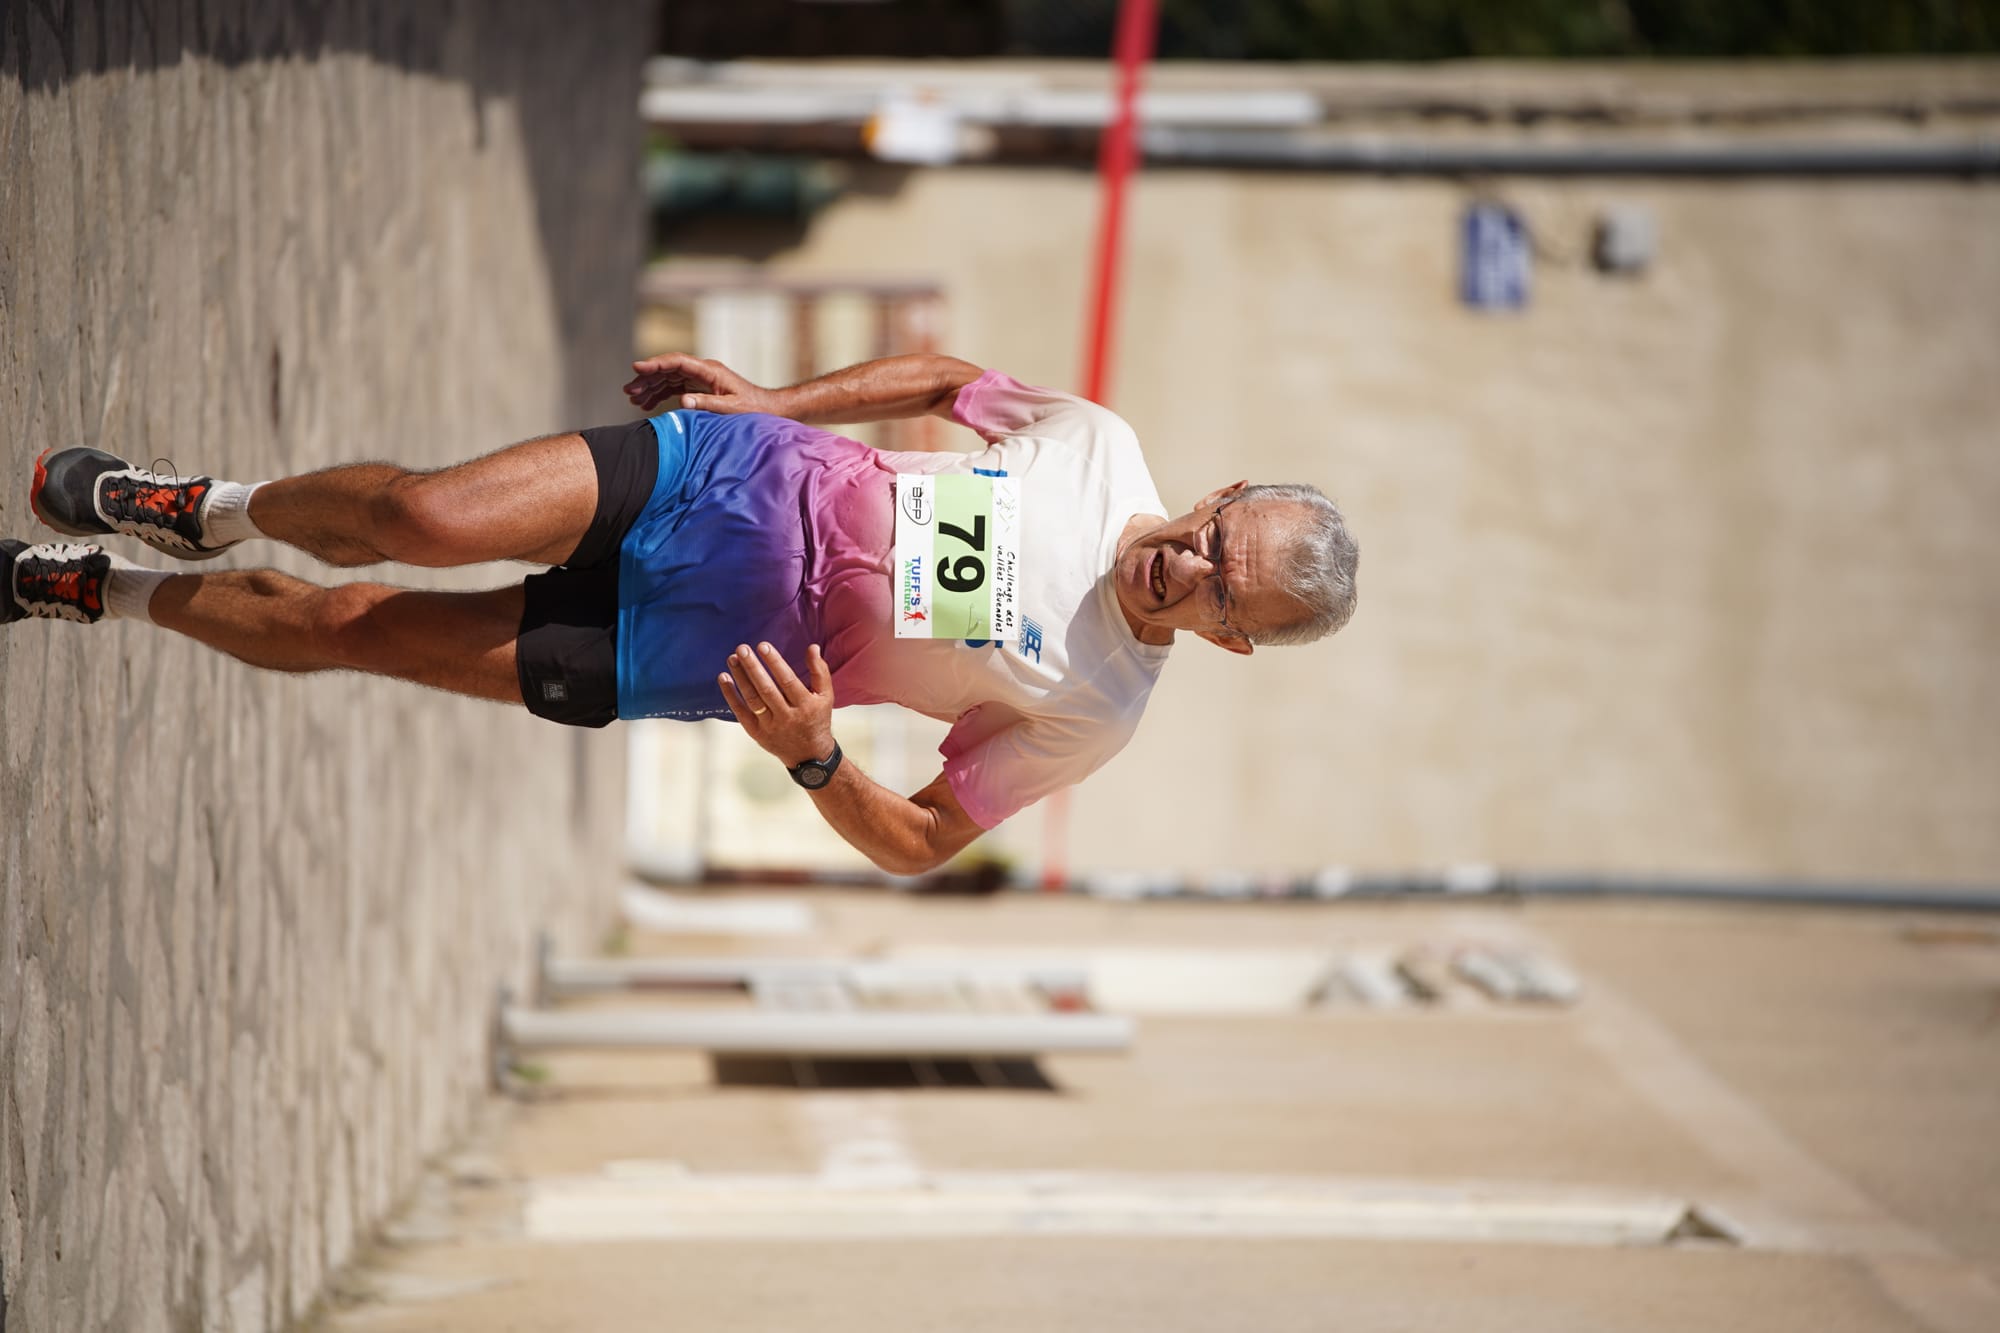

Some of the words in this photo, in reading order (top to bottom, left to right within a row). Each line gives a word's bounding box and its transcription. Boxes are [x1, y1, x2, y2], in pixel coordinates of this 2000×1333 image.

[912, 487, 922, 519] BFP
[936, 515, 986, 593] 79
[997, 545, 1005, 581] vallées
[1004, 552, 1016, 603] Challenge
[904, 560, 914, 612] Aventure
[911, 556, 921, 606] TUFF'S
[996, 587, 1004, 633] cévenoles
[1006, 610, 1014, 628] des
